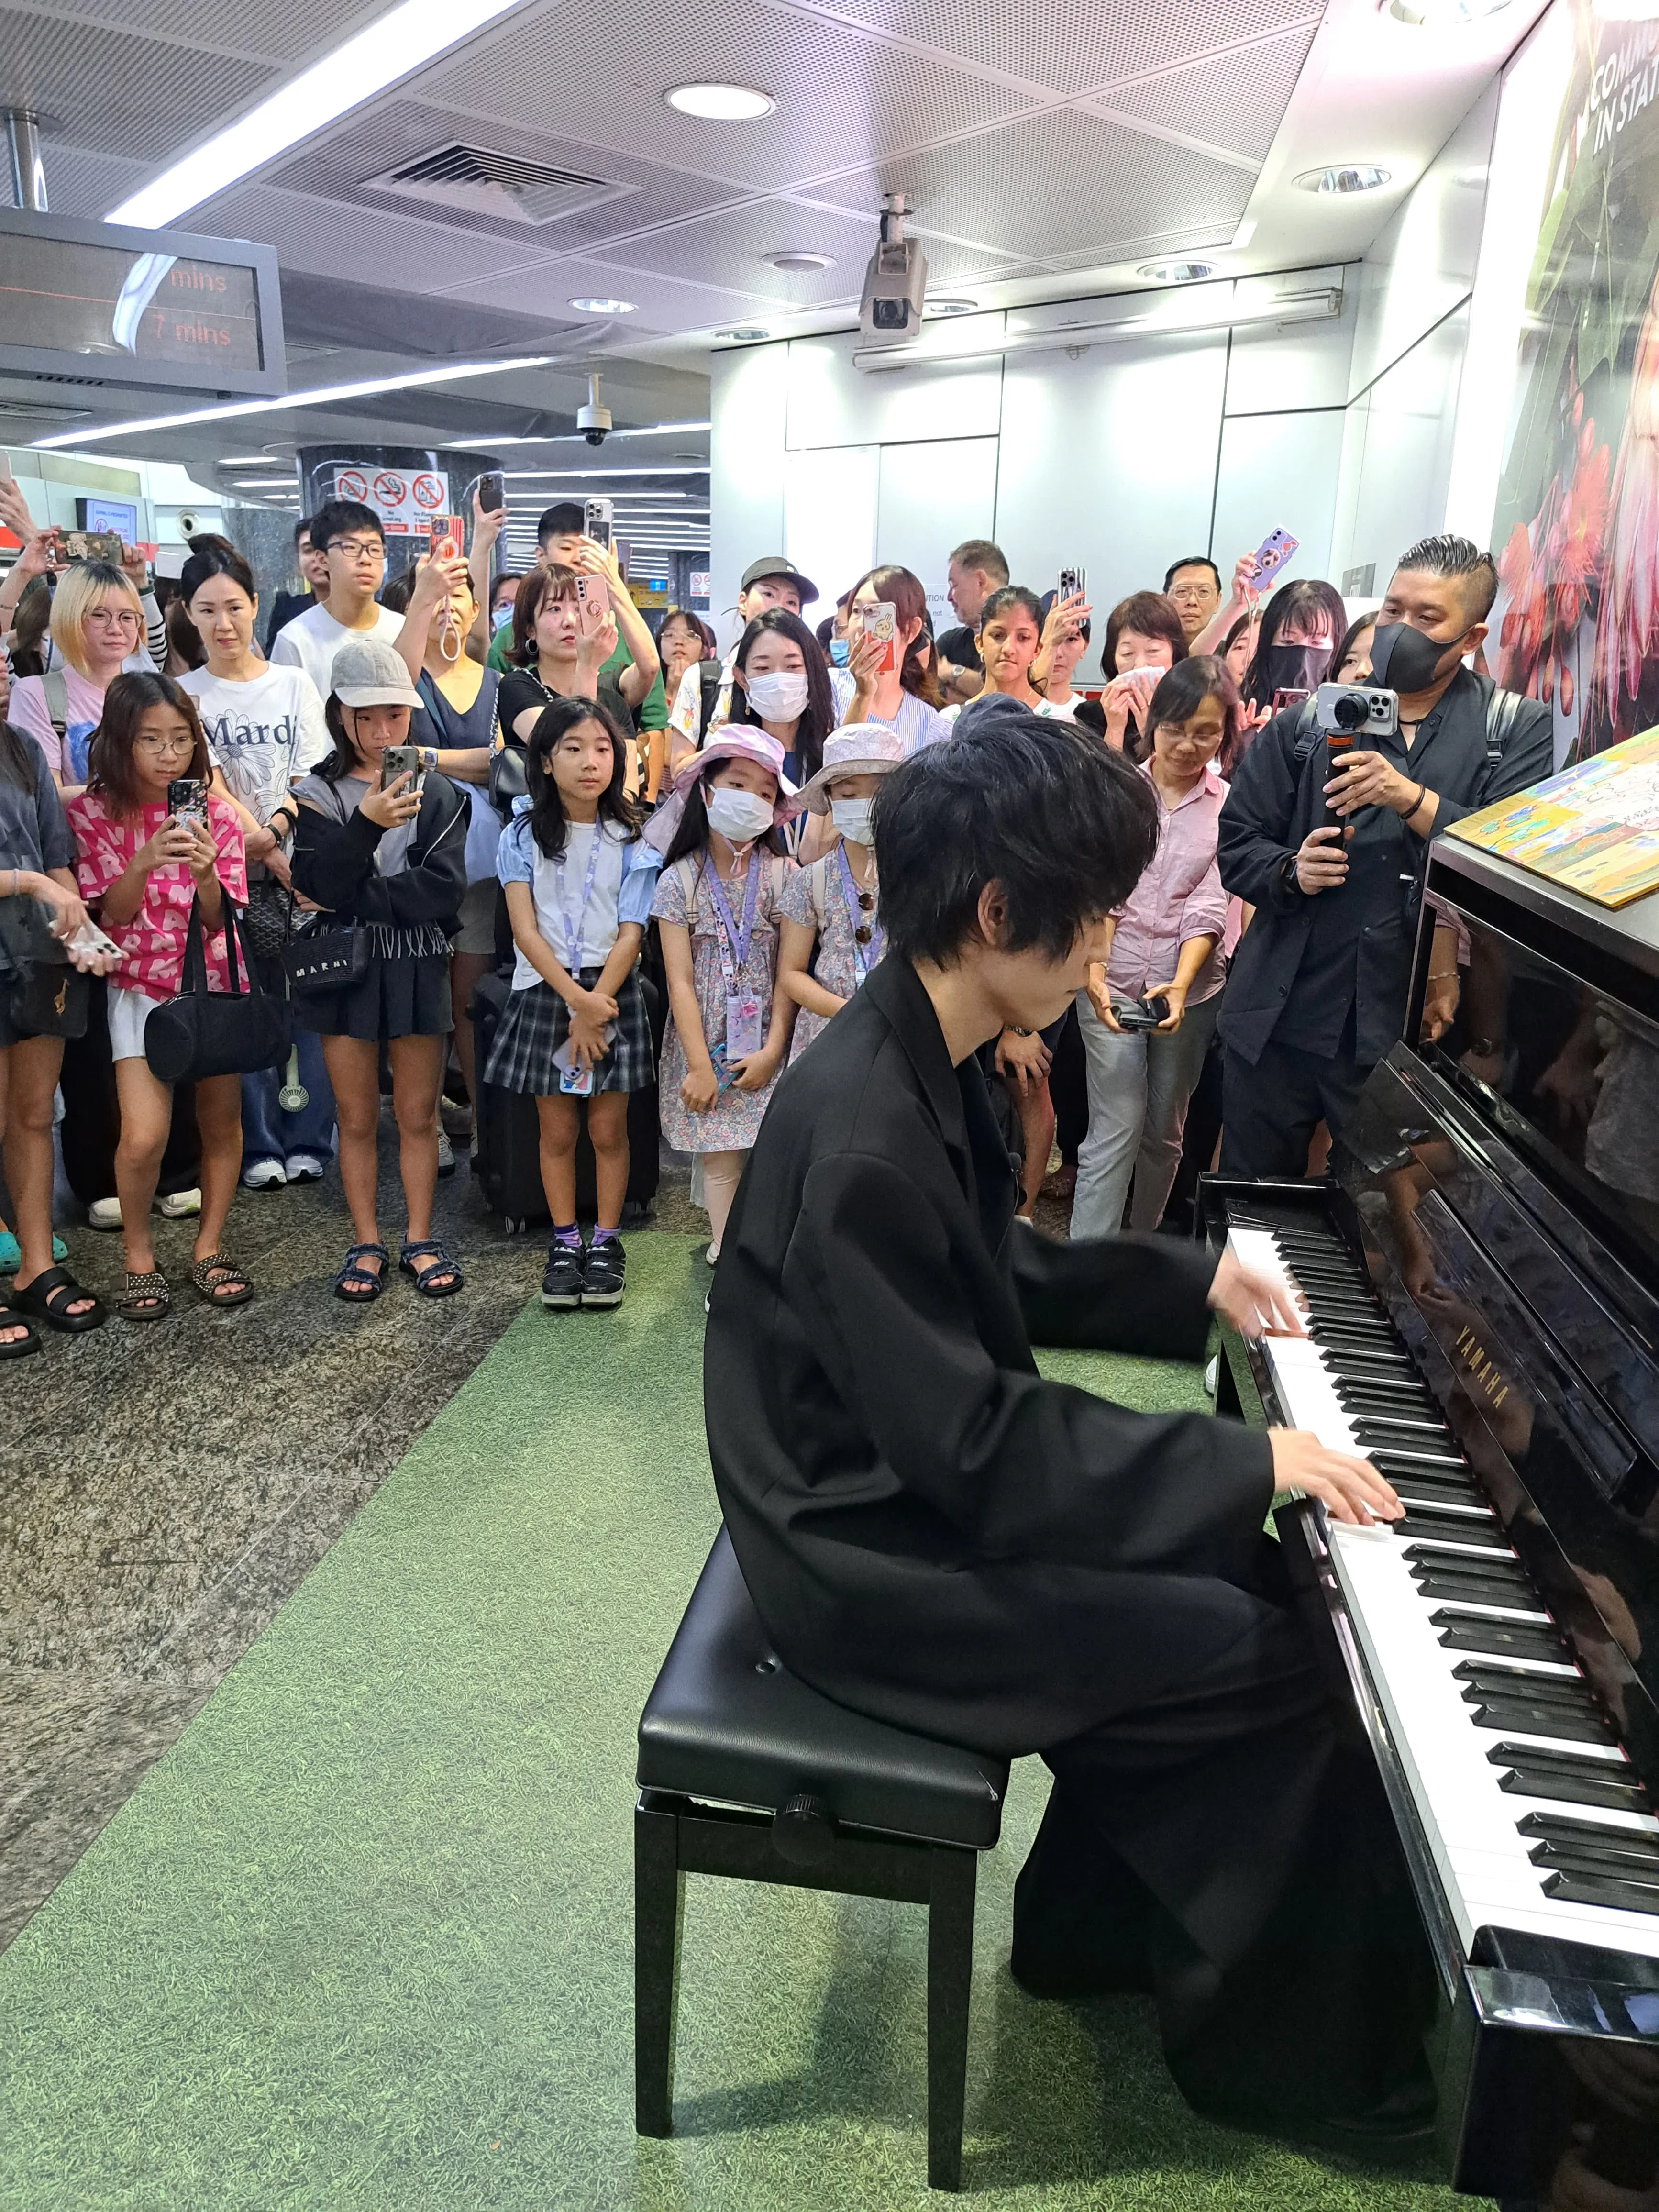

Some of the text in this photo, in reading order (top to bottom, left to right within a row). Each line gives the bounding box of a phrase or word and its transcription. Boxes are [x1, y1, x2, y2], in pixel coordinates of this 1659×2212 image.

[1593, 97, 1617, 155] IN
[171, 265, 227, 292] mins
[153, 314, 231, 346] 7 mins
[296, 959, 348, 977] MARNI
[1456, 1325, 1508, 1408] YAMAHA
